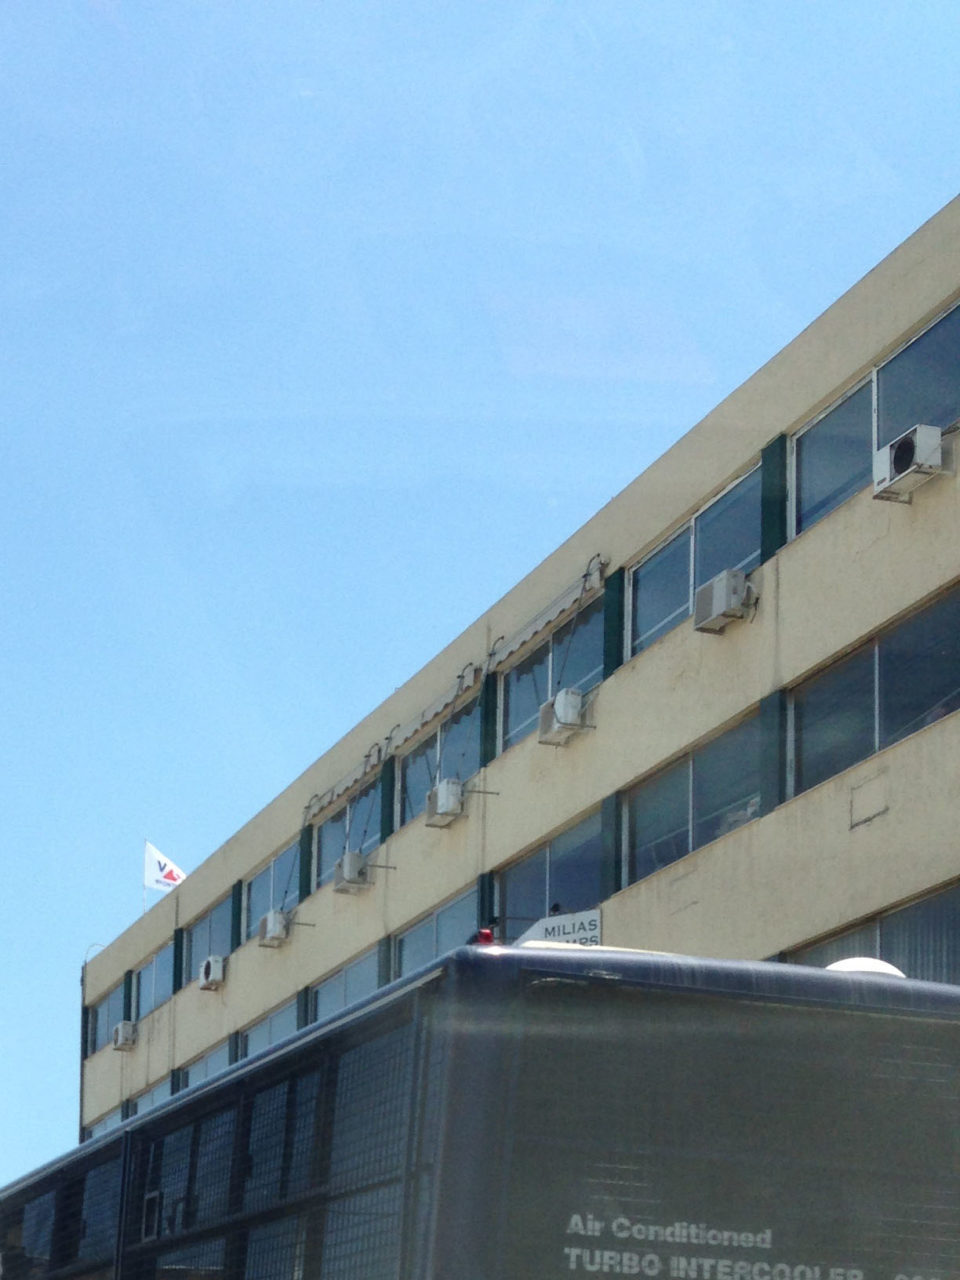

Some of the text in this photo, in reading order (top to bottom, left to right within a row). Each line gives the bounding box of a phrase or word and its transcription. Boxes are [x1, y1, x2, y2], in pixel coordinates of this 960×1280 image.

[545, 919, 598, 938] MILIAS
[566, 1214, 772, 1249] Air Conditioned
[564, 1247, 662, 1276] TURBO
